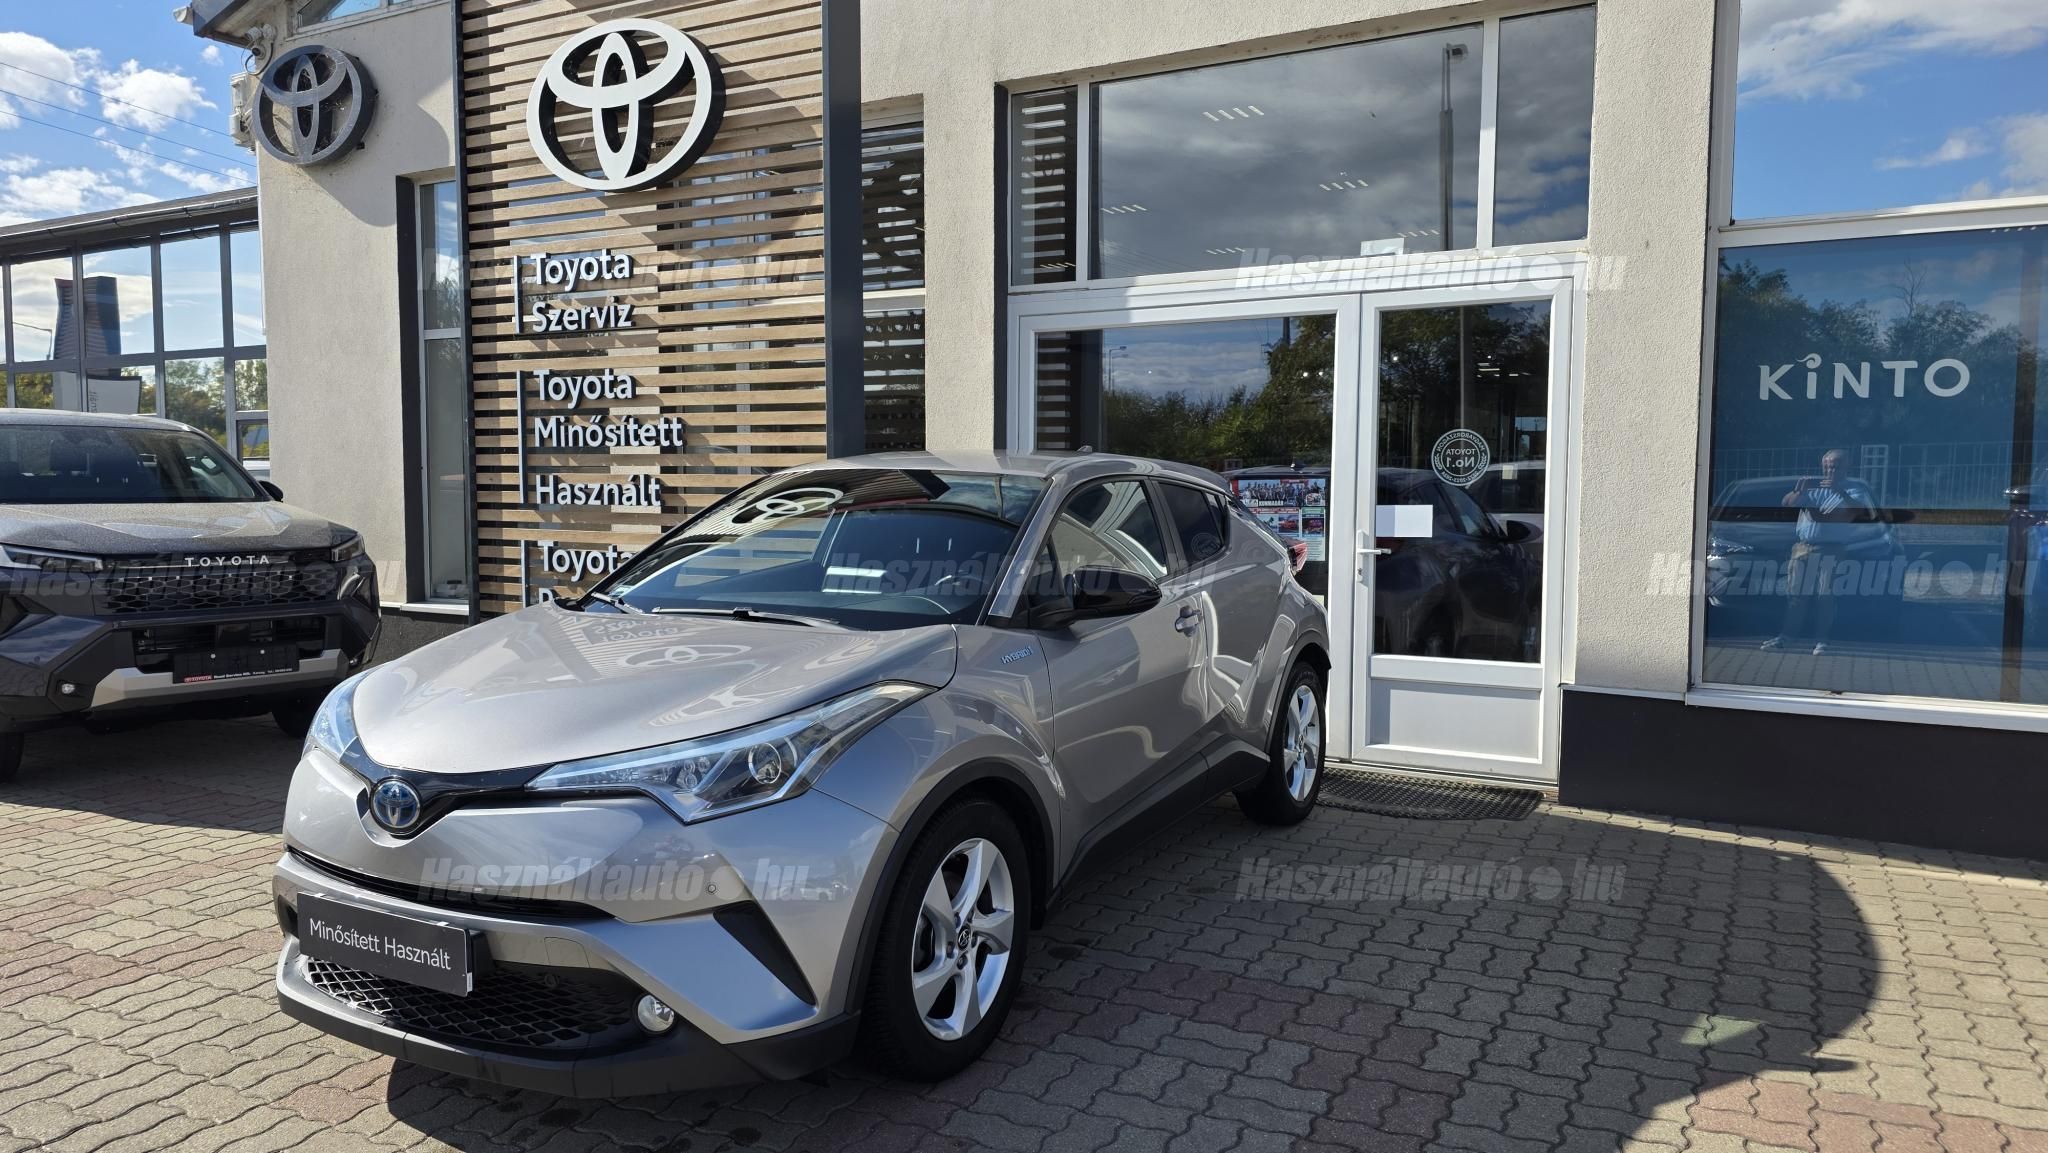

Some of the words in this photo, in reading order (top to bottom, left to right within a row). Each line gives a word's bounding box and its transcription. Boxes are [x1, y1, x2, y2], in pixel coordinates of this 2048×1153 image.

[530, 249, 632, 291] Toyota
[532, 296, 633, 332] Szerviz
[533, 368, 634, 409] Toyota
[534, 414, 684, 448] Minősített
[535, 472, 661, 507] Használt
[185, 555, 270, 568] TOYOTA
[1002, 646, 1033, 664] HYBRID
[309, 917, 381, 953] Minősített
[384, 936, 452, 970] Használt
